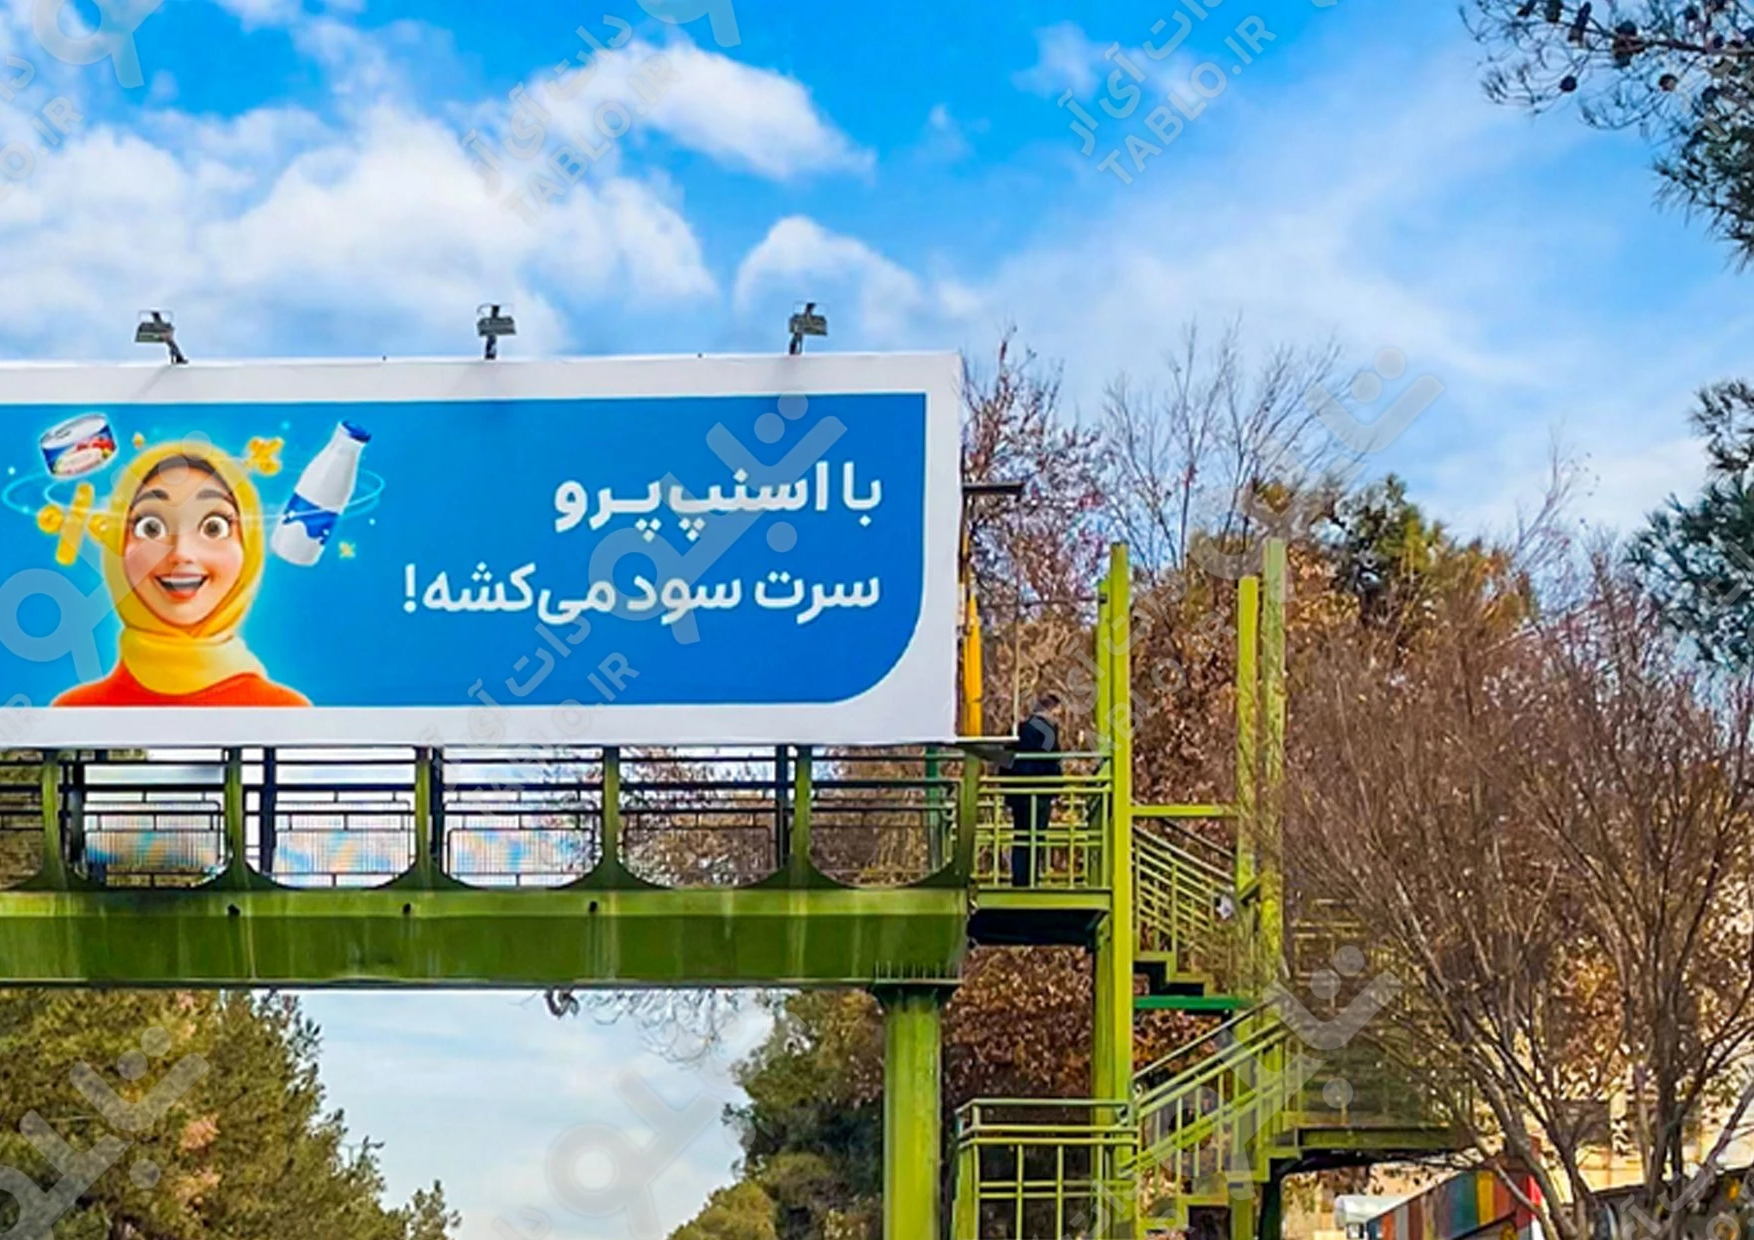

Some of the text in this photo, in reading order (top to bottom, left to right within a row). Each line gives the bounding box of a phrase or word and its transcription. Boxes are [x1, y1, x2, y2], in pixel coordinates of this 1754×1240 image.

[842, 460, 883, 527] با
[626, 575, 743, 625] سود
[754, 570, 880, 624] سرت
